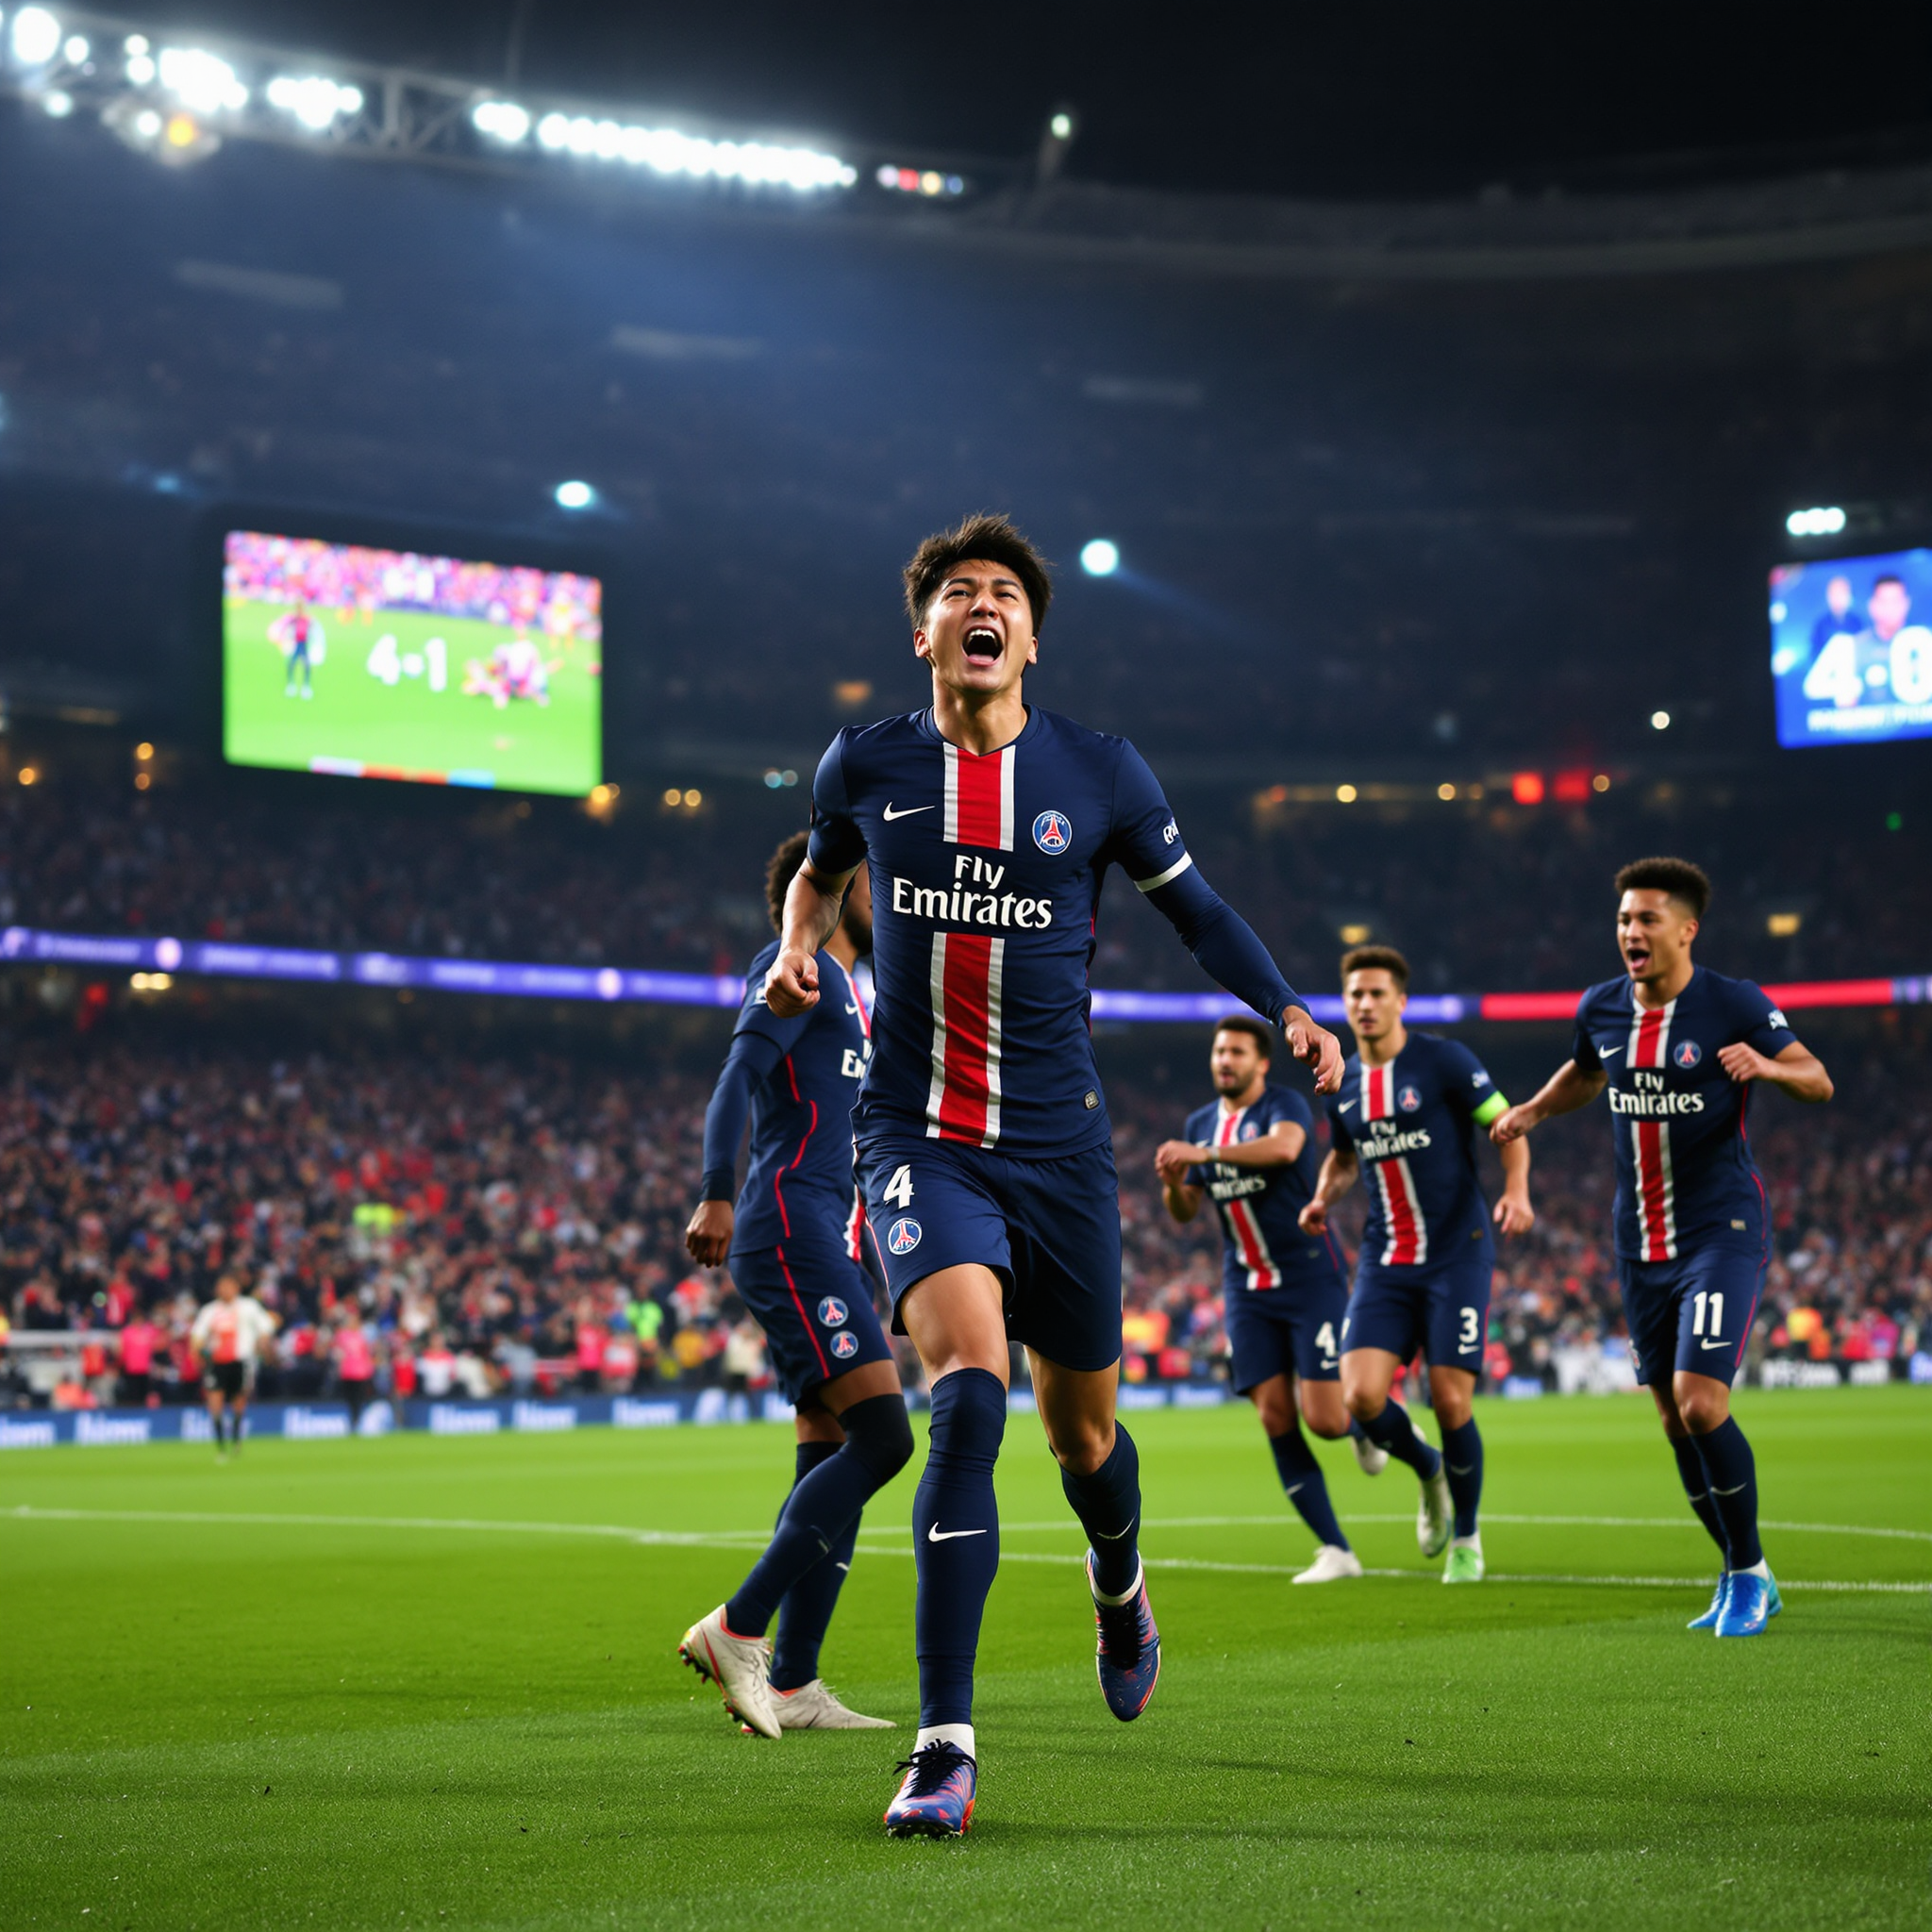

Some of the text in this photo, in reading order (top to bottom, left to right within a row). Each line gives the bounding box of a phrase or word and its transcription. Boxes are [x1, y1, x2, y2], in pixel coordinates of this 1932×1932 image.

[955, 855, 1005, 890] Fly
[892, 876, 1053, 929] Emirates
[1634, 1072, 1664, 1092] Fly
[1608, 1087, 1705, 1115] Emirates
[883, 1164, 914, 1208] 4
[1459, 1307, 1479, 1343] 3
[1692, 1291, 1724, 1337] 11
[1315, 1321, 1336, 1357] 4
